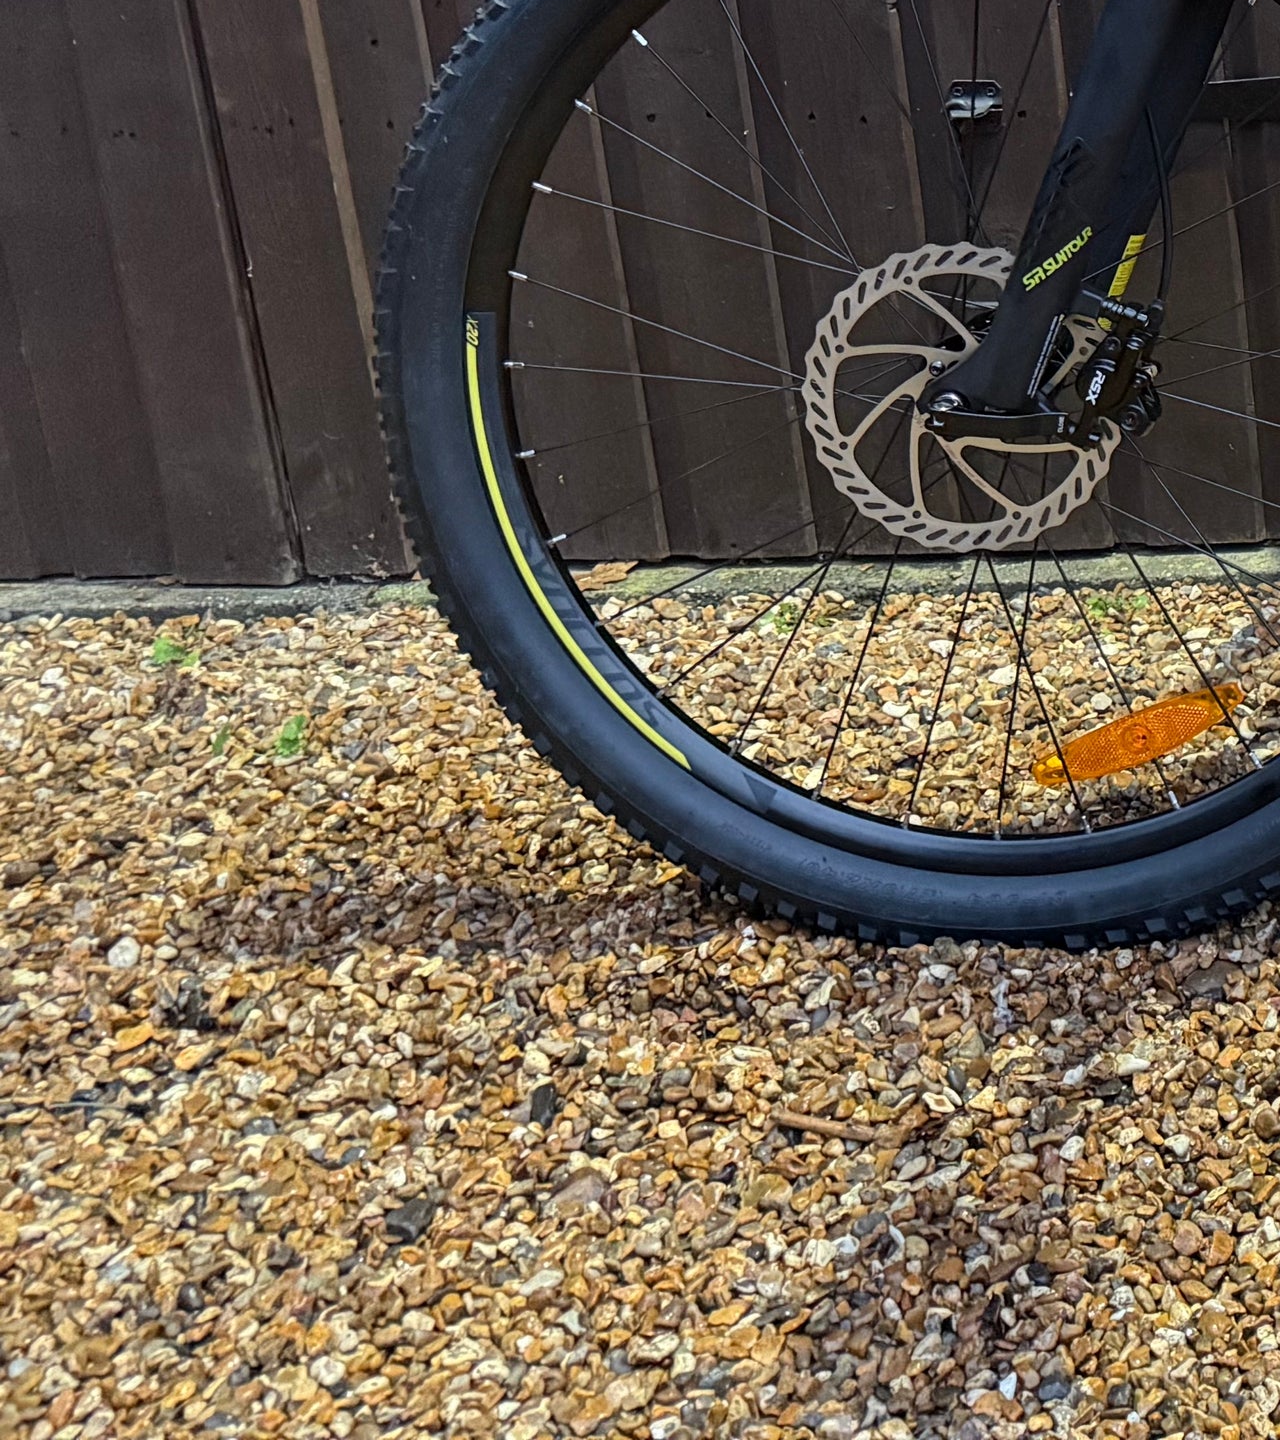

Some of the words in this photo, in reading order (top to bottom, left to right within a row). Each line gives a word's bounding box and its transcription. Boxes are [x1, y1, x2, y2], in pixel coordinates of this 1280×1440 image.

[1022, 266, 1047, 292] SR
[1042, 226, 1093, 277] SUNTOUR
[1085, 370, 1106, 406] RSX
